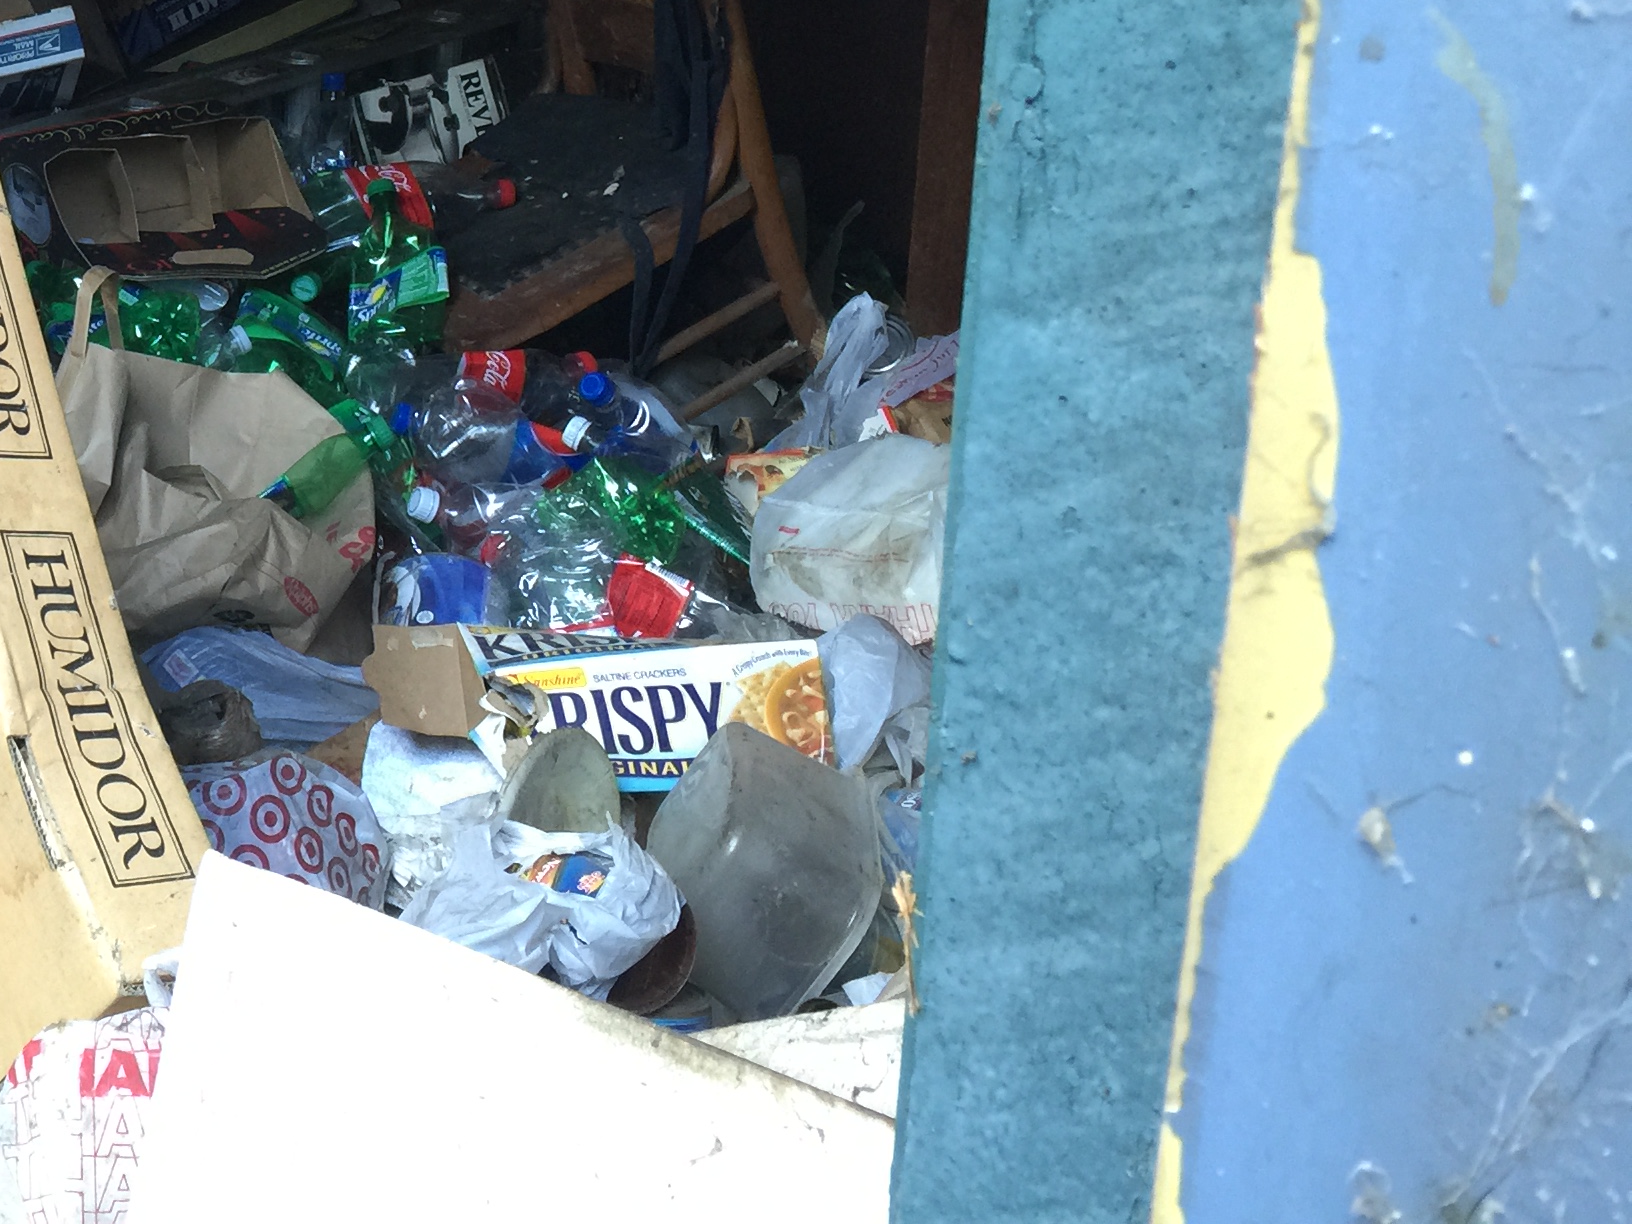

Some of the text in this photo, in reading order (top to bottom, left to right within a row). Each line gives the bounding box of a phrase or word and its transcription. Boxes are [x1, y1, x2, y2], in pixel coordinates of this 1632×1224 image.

[13, 39, 35, 51] MAIL
[593, 667, 687, 684] SALTINE CRACKERS
[23, 549, 167, 870] HUMIDOR
[548, 681, 723, 756] RISPY
